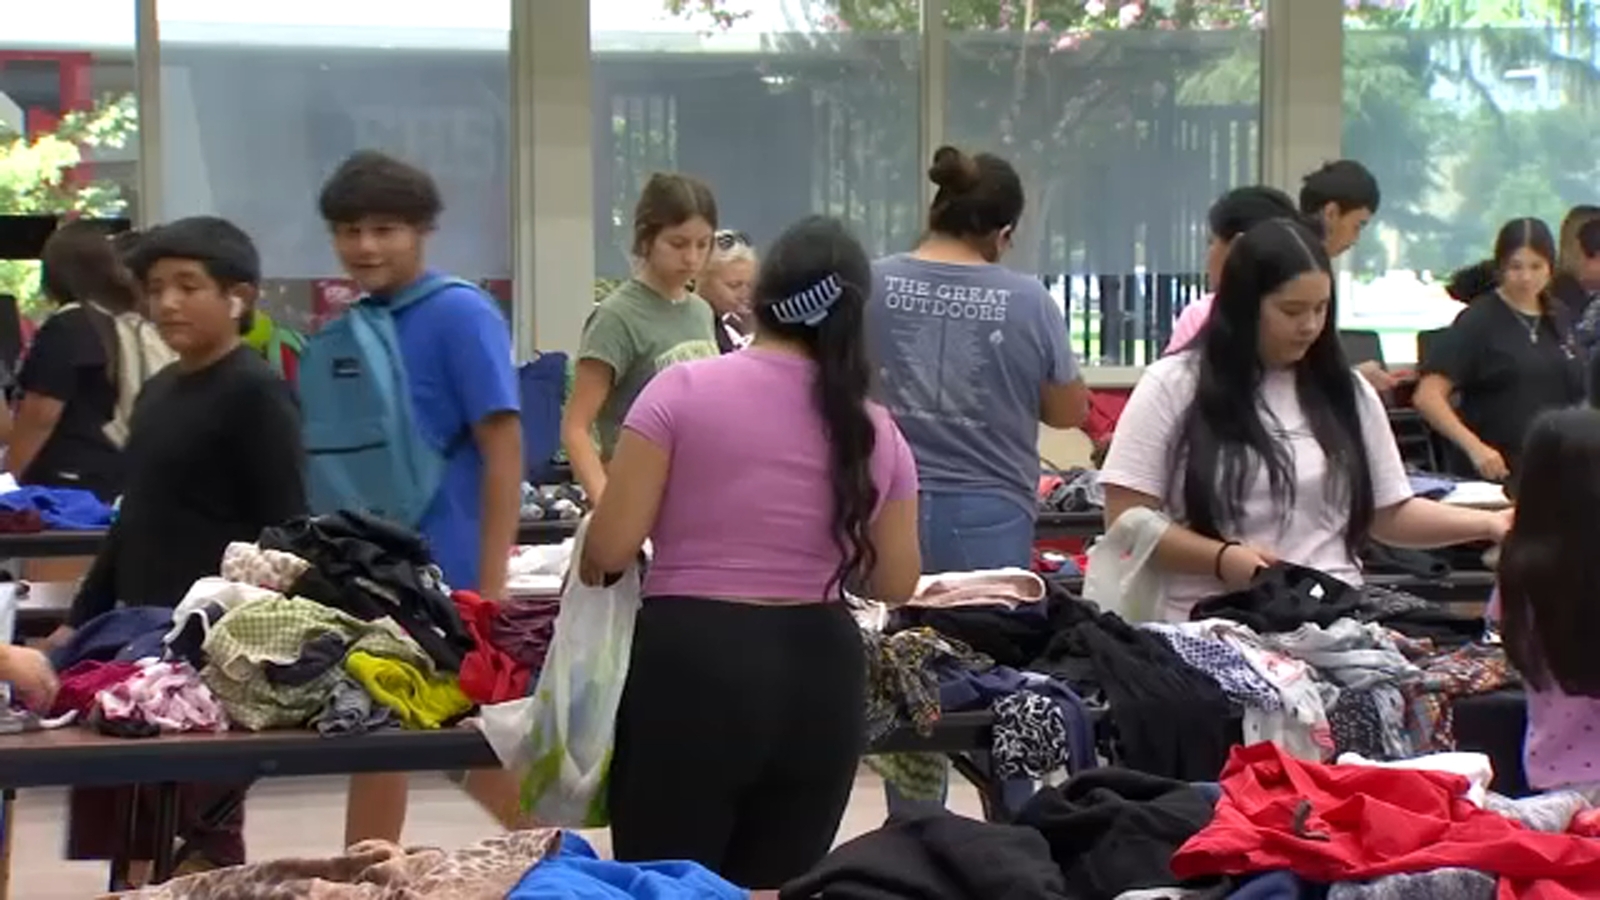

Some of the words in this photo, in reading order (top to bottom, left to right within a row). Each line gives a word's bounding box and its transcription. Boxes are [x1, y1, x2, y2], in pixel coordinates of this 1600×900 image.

[884, 275, 931, 296] THE
[936, 285, 1010, 305] GREAT
[885, 292, 1006, 321] OUTDOORS
